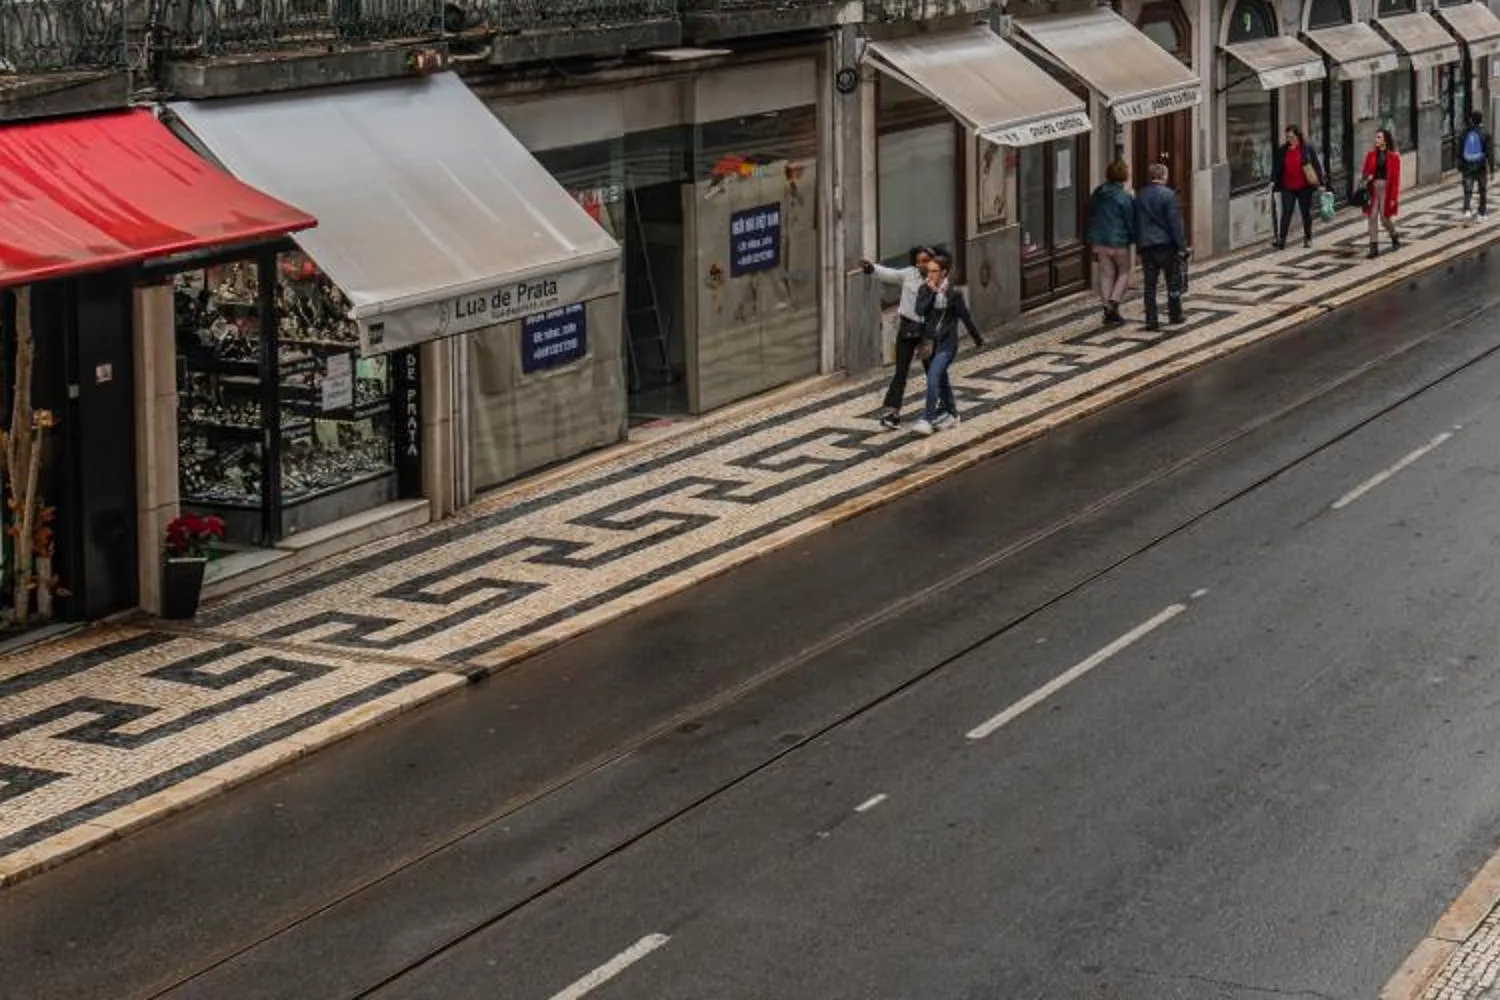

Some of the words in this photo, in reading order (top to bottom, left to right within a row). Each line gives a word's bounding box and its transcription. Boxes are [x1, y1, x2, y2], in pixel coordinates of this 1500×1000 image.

[455, 294, 487, 319] Lua
[491, 288, 511, 307] de
[517, 279, 558, 301] Prata
[406, 353, 417, 380] DE
[407, 389, 418, 456] PRATA
